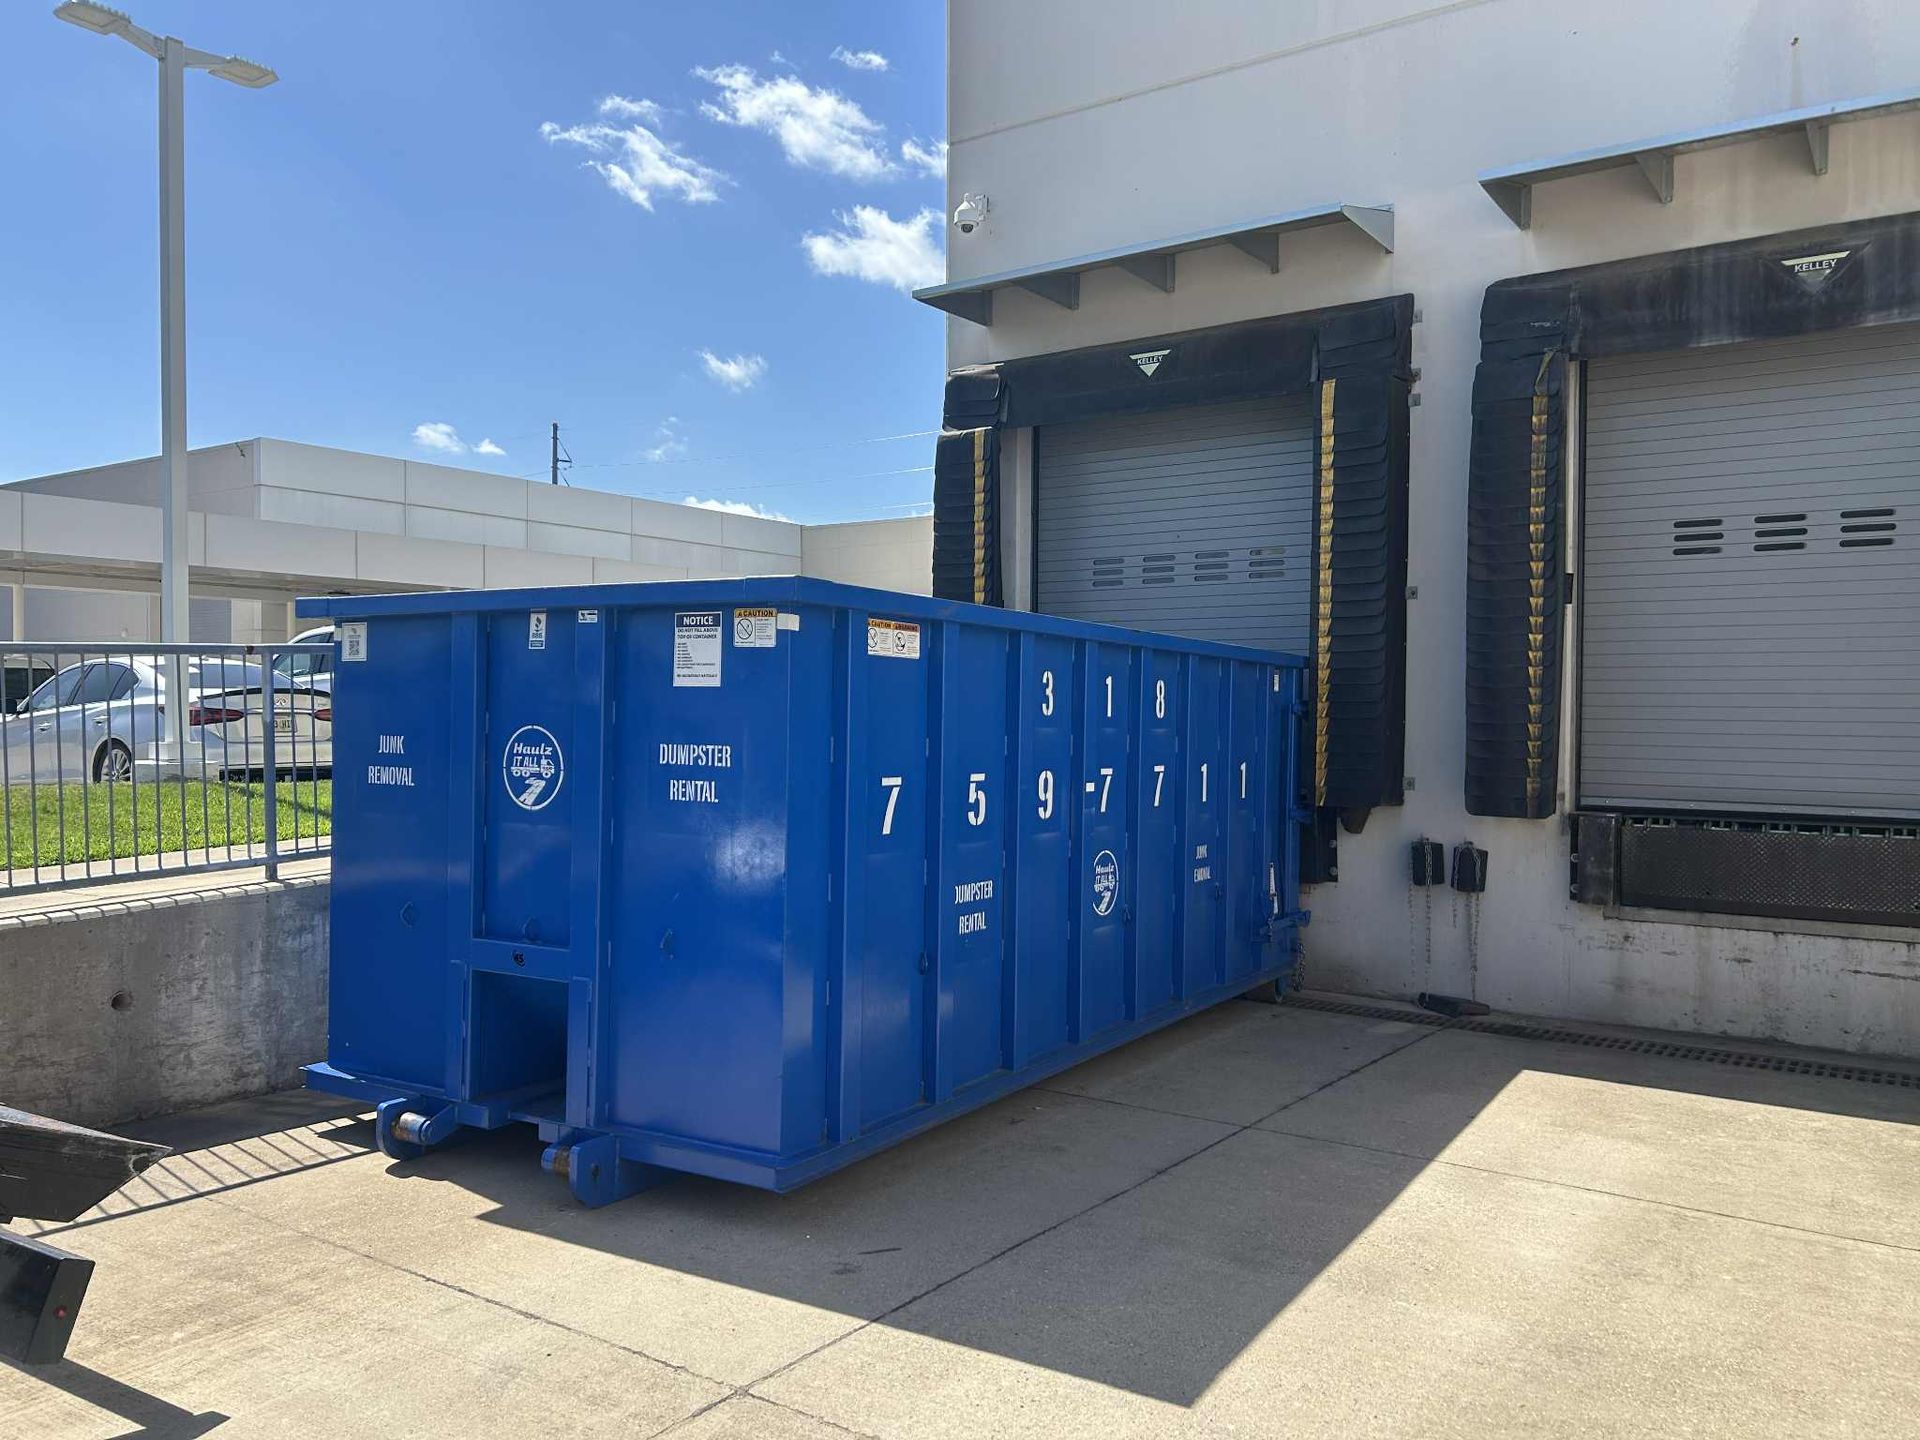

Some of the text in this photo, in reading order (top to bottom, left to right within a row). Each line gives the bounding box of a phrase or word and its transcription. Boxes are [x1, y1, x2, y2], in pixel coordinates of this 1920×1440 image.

[1794, 259, 1837, 272] KELLEY
[1137, 356, 1163, 365] KELLEY
[683, 616, 714, 625] NOTICE
[1042, 671, 1165, 718] 3 1 8
[378, 735, 404, 754] JUNK
[513, 743, 553, 755] Haulz
[513, 756, 539, 767] IT ALL
[659, 744, 731, 767] DUMPSTER
[368, 765, 415, 786] REMOVAL
[669, 780, 719, 803] RENTAL
[881, 776, 902, 835] 7
[968, 773, 986, 826] 5
[1038, 770, 1054, 820] 9
[1154, 765, 1165, 807] 7
[1201, 763, 1208, 802] 1
[1240, 762, 1246, 799] 1
[959, 911, 987, 935] RENTAL
